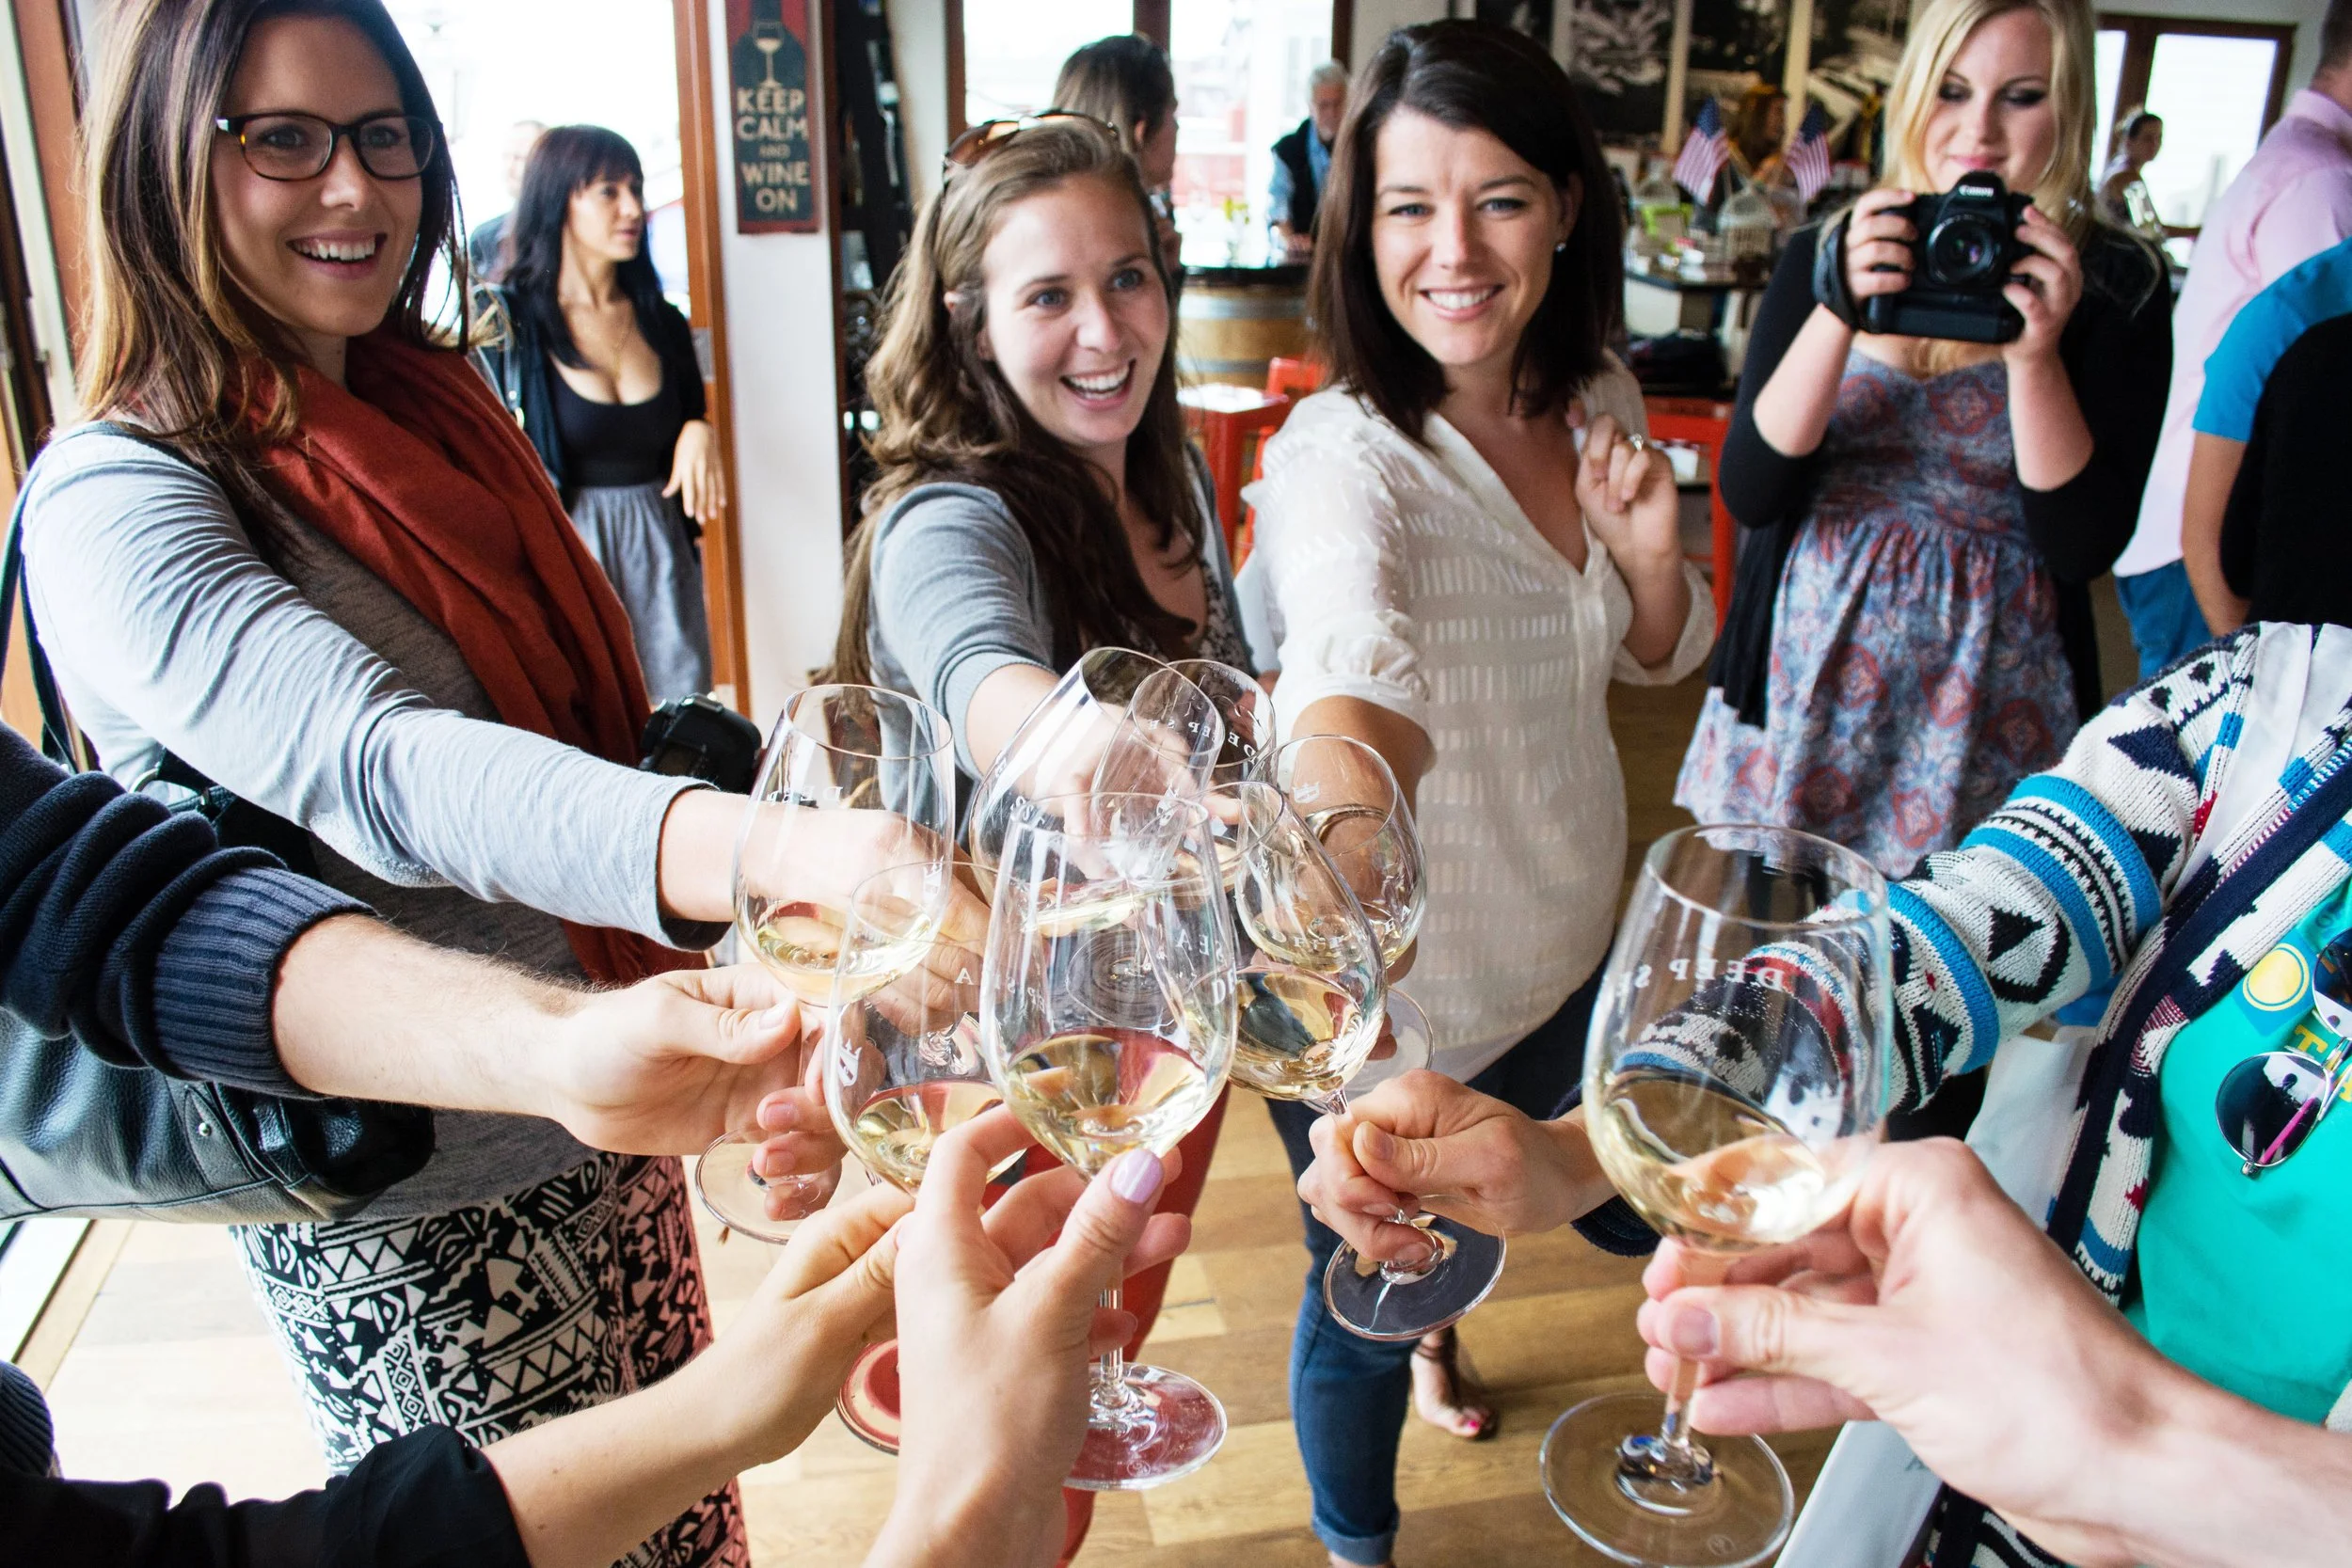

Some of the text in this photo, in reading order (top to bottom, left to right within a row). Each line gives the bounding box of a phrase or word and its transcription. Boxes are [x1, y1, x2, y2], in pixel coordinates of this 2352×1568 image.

[737, 87, 805, 115] KEEP
[737, 115, 809, 141] CALM
[759, 143, 791, 159] AND
[740, 161, 810, 186] WINE
[755, 187, 798, 213] ON
[1958, 184, 1994, 198] Canon
